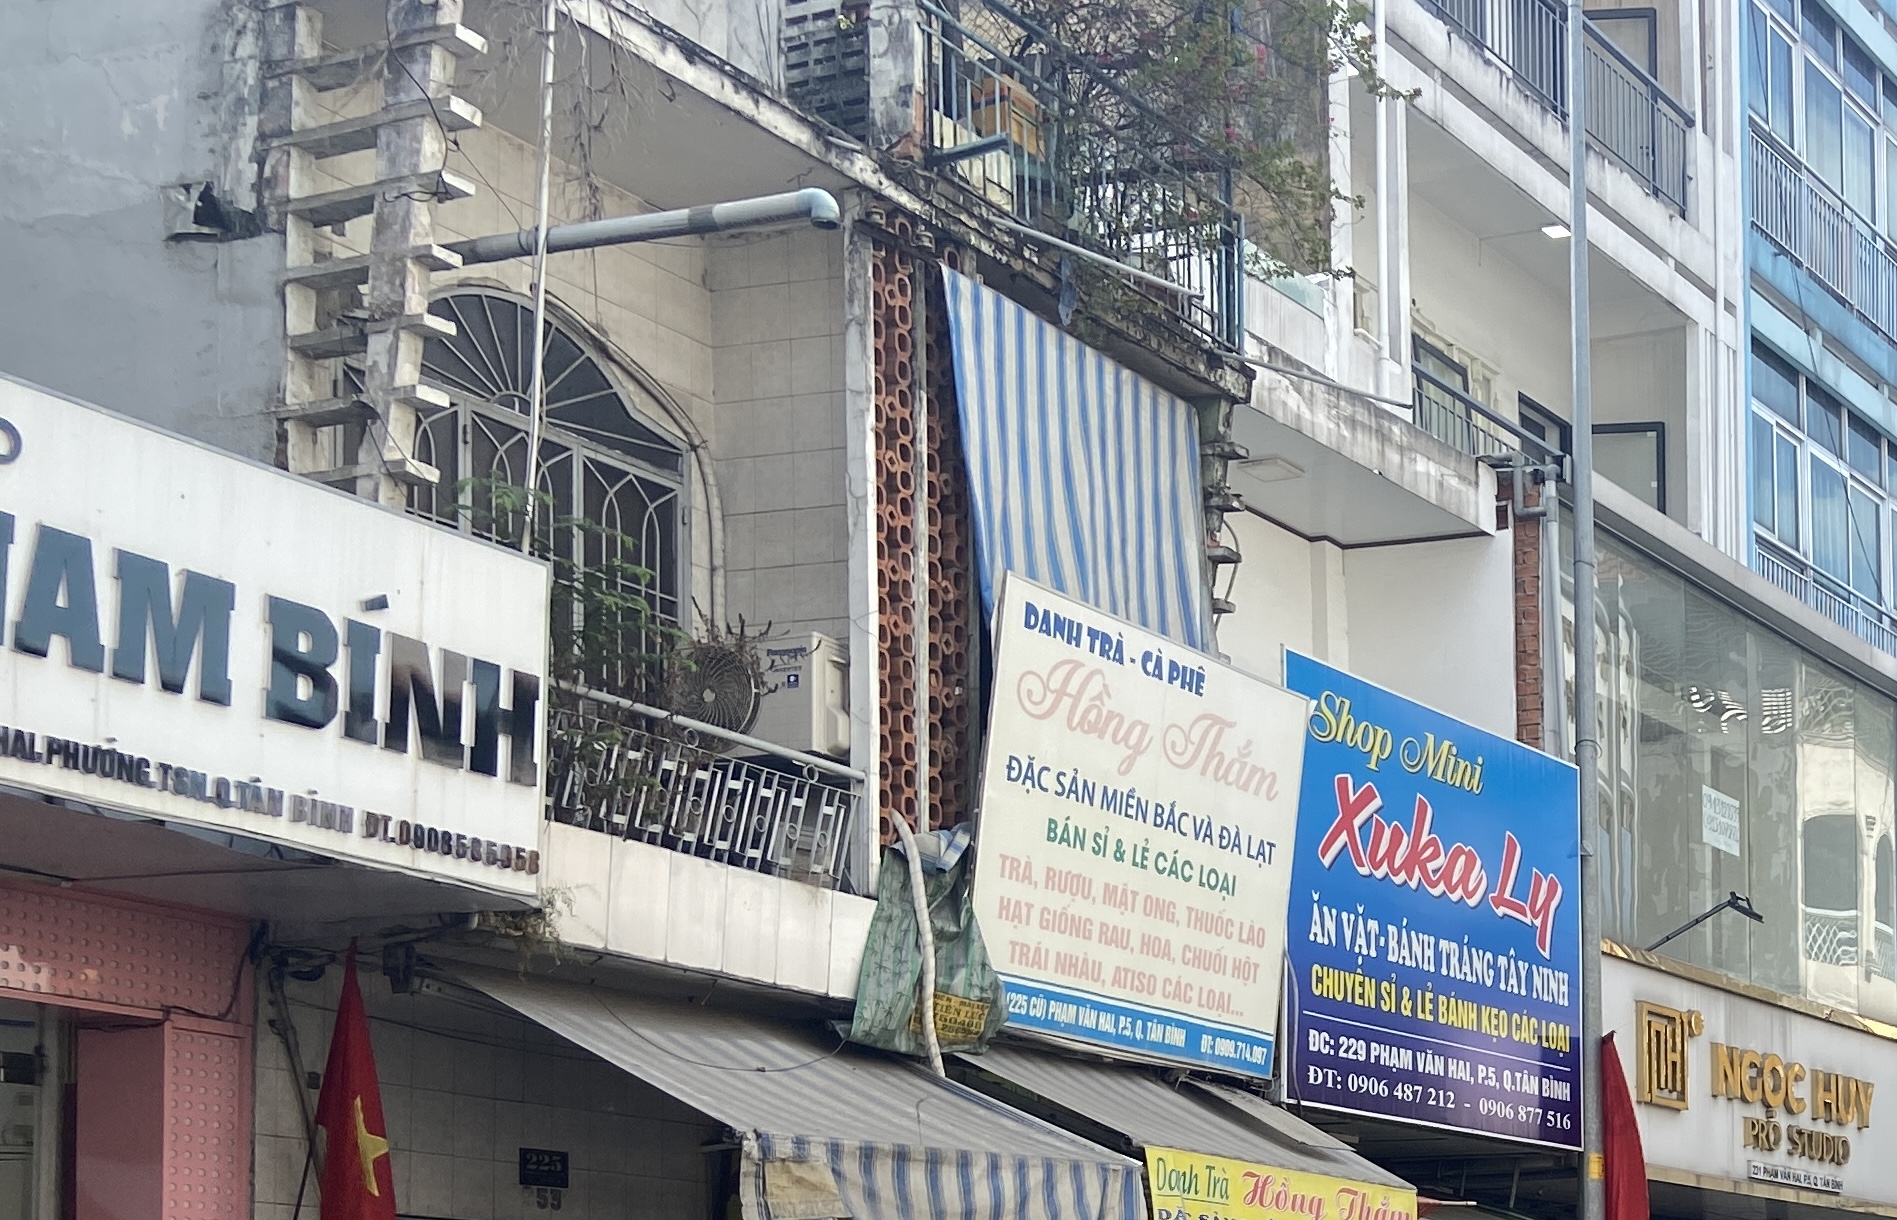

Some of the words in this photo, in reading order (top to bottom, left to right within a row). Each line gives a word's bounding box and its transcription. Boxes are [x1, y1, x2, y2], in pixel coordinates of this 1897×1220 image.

[0, 511, 235, 706] AM
[1024, 601, 1083, 648] DANH
[1087, 627, 1125, 666] TRÀ
[1141, 648, 1163, 680] CÀ
[1168, 660, 1206, 697] PHÊ
[1017, 659, 1153, 776] Hồng
[1163, 713, 1279, 801] Thắm
[1308, 690, 1393, 772] Shop
[1400, 731, 1484, 794] Mini
[1006, 755, 1051, 794] ĐẶC
[1055, 768, 1095, 806] SẢN
[1100, 787, 1149, 823] MIỀN
[1153, 801, 1187, 837] BẮC
[1193, 814, 1214, 845] VÀ
[1218, 824, 1241, 855] ĐÀ
[1247, 839, 1277, 869] LẠT
[1046, 816, 1085, 851] BÁN
[1092, 822, 1108, 857] SỈ
[1113, 839, 1126, 863] &
[1132, 838, 1149, 871] LẺ
[1154, 849, 1194, 883] CÁC
[1199, 865, 1237, 901] LOẠI
[999, 853, 1037, 890] TRÀ,
[1045, 866, 1096, 903] RƯỢU,
[1103, 881, 1139, 918] MẬT
[1143, 894, 1179, 928] ONG,
[1186, 905, 1234, 940] THUỐC
[1238, 919, 1266, 949] LÀO
[1318, 774, 1488, 908] Xuka
[1489, 830, 1563, 960] Ly
[998, 896, 1034, 929] HẠT
[1039, 904, 1093, 940] GIỐNG
[1098, 923, 1134, 954] RAU,
[1140, 932, 1176, 965] HOA,
[1181, 943, 1227, 975] CHUỐI
[1232, 957, 1261, 990] HỘT
[1009, 940, 1049, 971] TRÁI
[1112, 966, 1157, 996] ATISO
[1162, 976, 1194, 1006] CÁC
[1309, 889, 1338, 947] ĂN
[1439, 934, 1495, 988] TRÁNG
[1497, 947, 1529, 997] TÂY
[1532, 965, 1569, 1007] NINH
[1006, 992, 1028, 1015] (225
[1048, 1000, 1077, 1027] PHẠM
[1079, 1004, 1098, 1030] VĂN
[1147, 1019, 1164, 1042] TÂN
[1165, 1022, 1186, 1048] BÌNH
[1311, 963, 1376, 1009] CHUYÊN
[1380, 972, 1397, 1014] SỈ
[1400, 986, 1413, 1017] &
[1416, 981, 1434, 1023] LẺ
[1438, 991, 1477, 1032] BÁNH
[1481, 1005, 1507, 1043] KẸO
[1511, 1009, 1538, 1046] CÁC
[1541, 1019, 1570, 1058] LOẠI
[1307, 1065, 1342, 1090] ĐT:
[1347, 1073, 1389, 1099] 0906
[1393, 1081, 1422, 1104] 487
[1427, 1087, 1456, 1110] 212
[1479, 1097, 1514, 1121] 0906
[1517, 1104, 1543, 1127] 877
[1546, 1110, 1571, 1131] 516
[1308, 1028, 1335, 1056] ĐC:
[1338, 1036, 1366, 1062] 229
[1370, 1042, 1412, 1073] PHẠM
[1416, 1048, 1444, 1077] VĂN
[1448, 1061, 1475, 1086] HAI,
[1541, 1076, 1571, 1102] BÌNH
[1811, 1068, 1874, 1130] HUY
[1156, 1157, 1200, 1195] Danh
[1205, 1165, 1229, 1200] Trà
[1787, 1124, 1851, 1166] STUDIO
